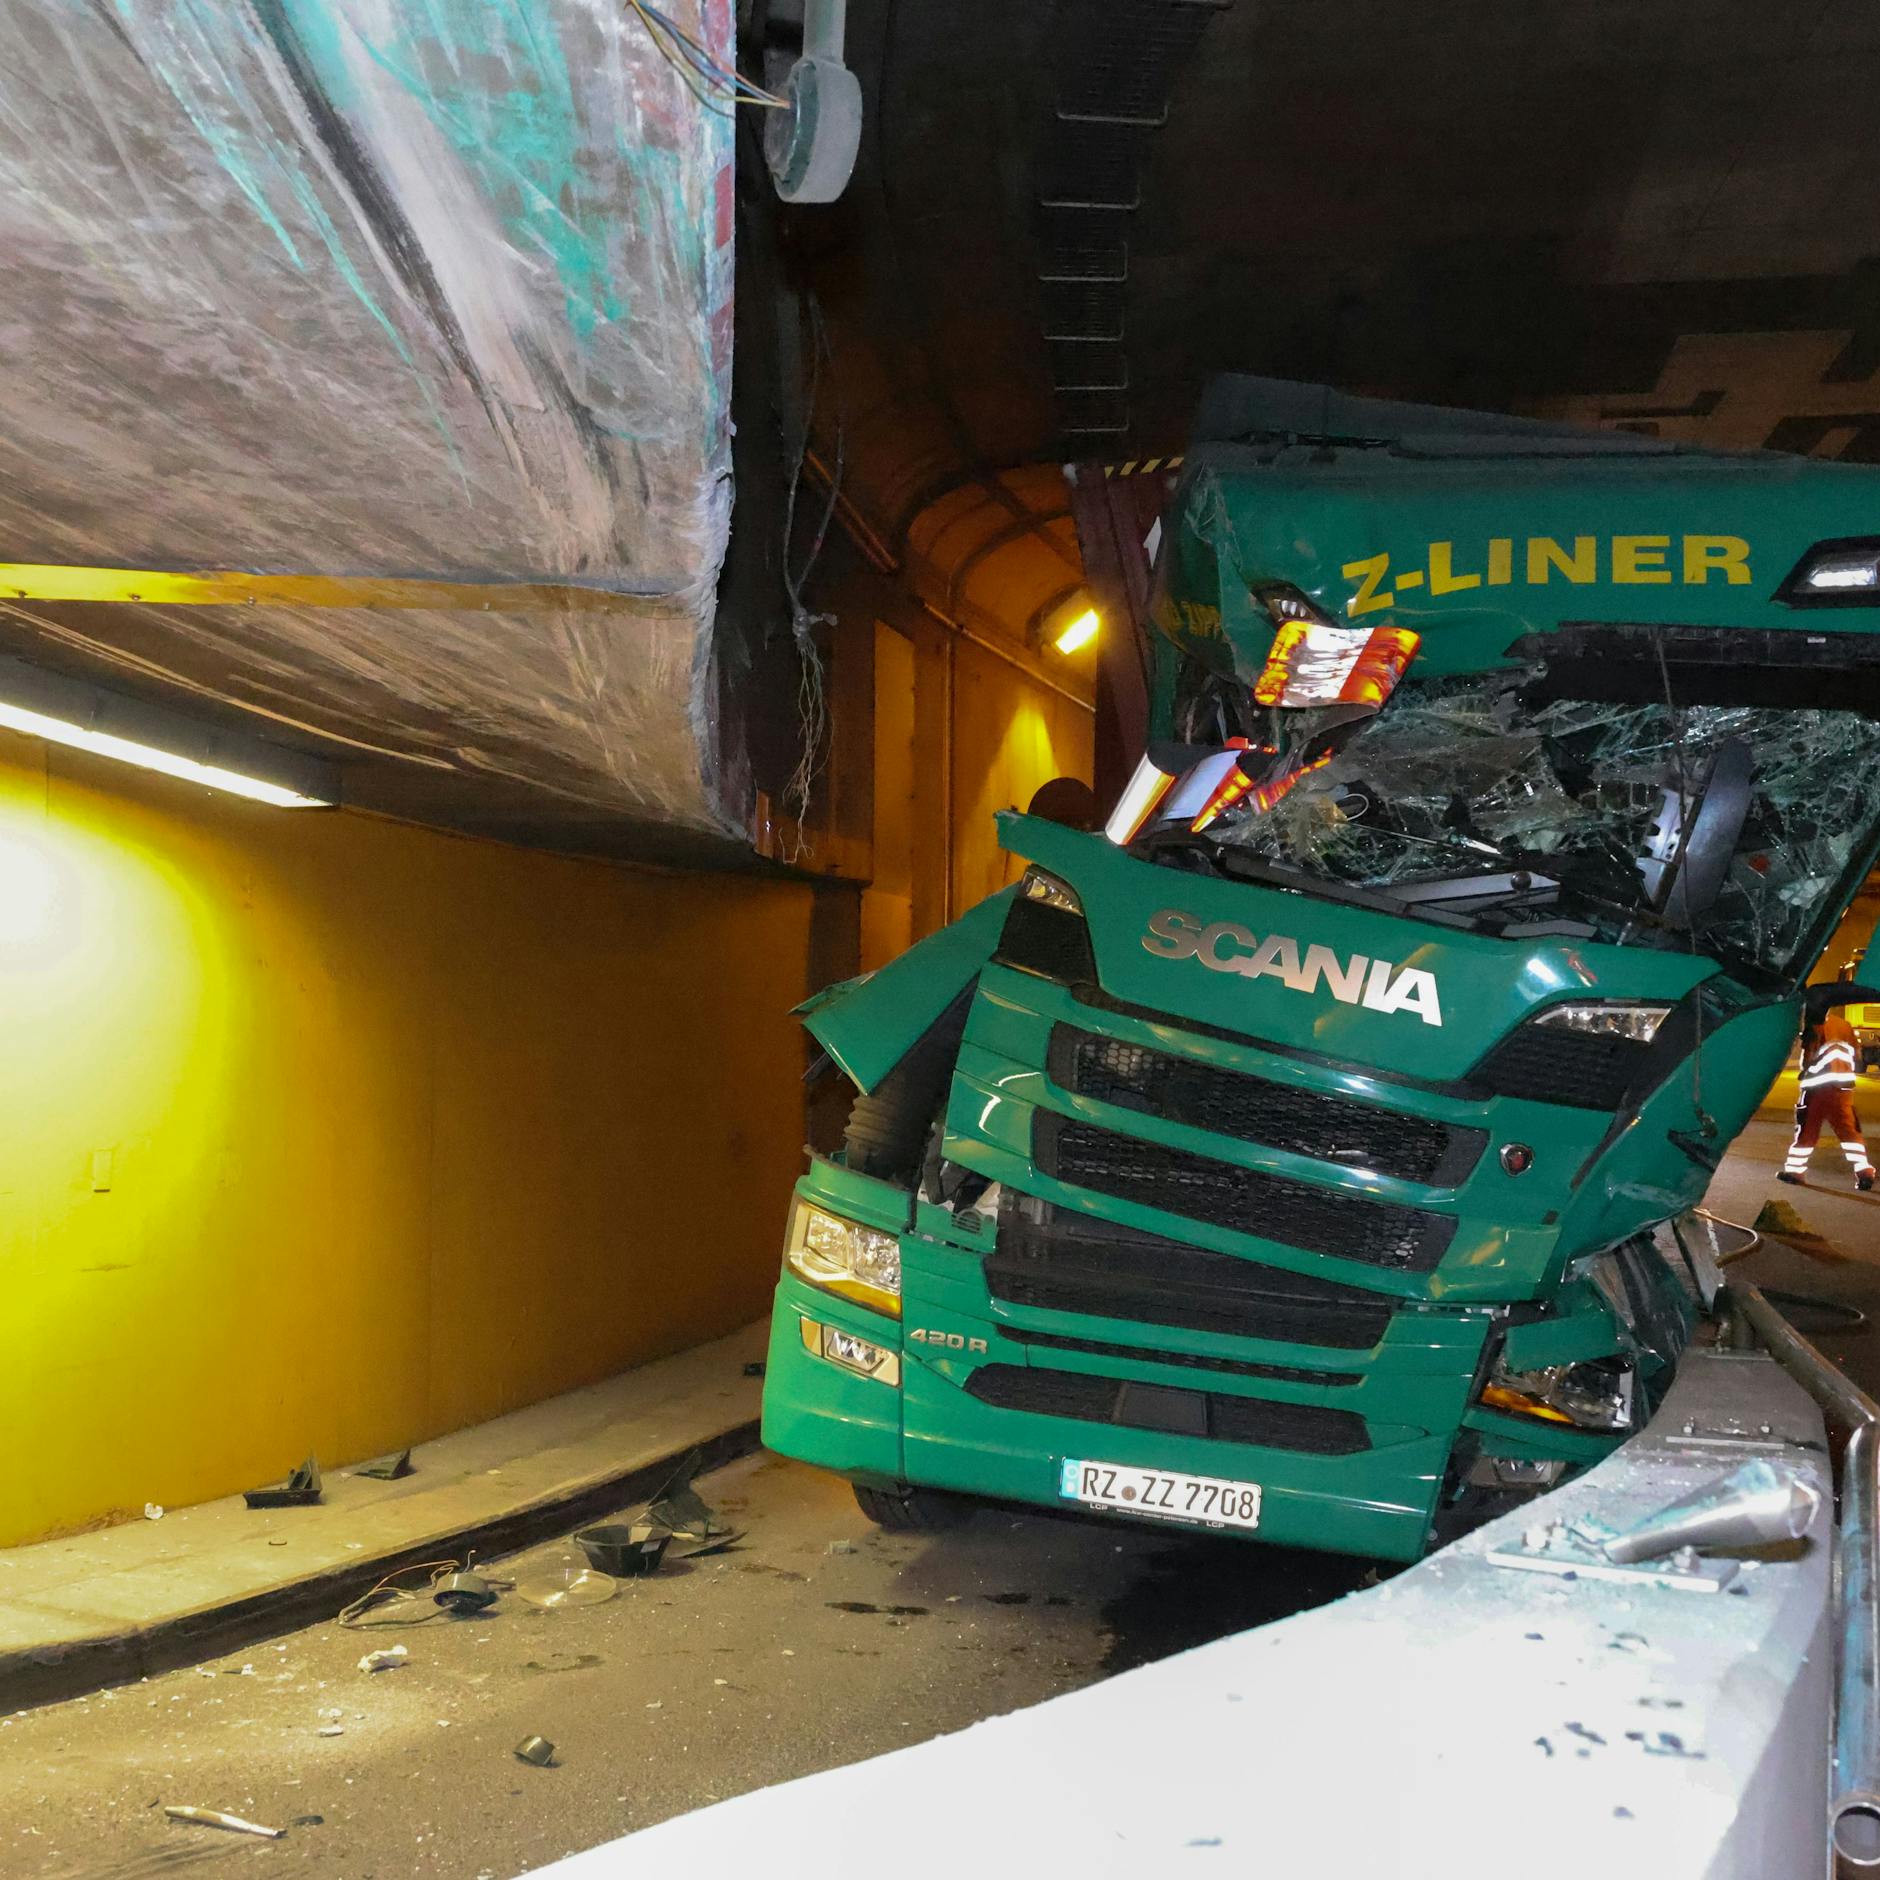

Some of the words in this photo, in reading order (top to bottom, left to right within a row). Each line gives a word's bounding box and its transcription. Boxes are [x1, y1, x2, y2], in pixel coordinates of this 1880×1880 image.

[1342, 535, 1752, 618] Z-LINER
[1141, 909, 1443, 1027] SCANIA
[910, 1328, 965, 1351] 420
[1082, 1467, 1117, 1500] RZ
[1140, 1475, 1175, 1508] ZZ
[1184, 1482, 1255, 1520] 7708
